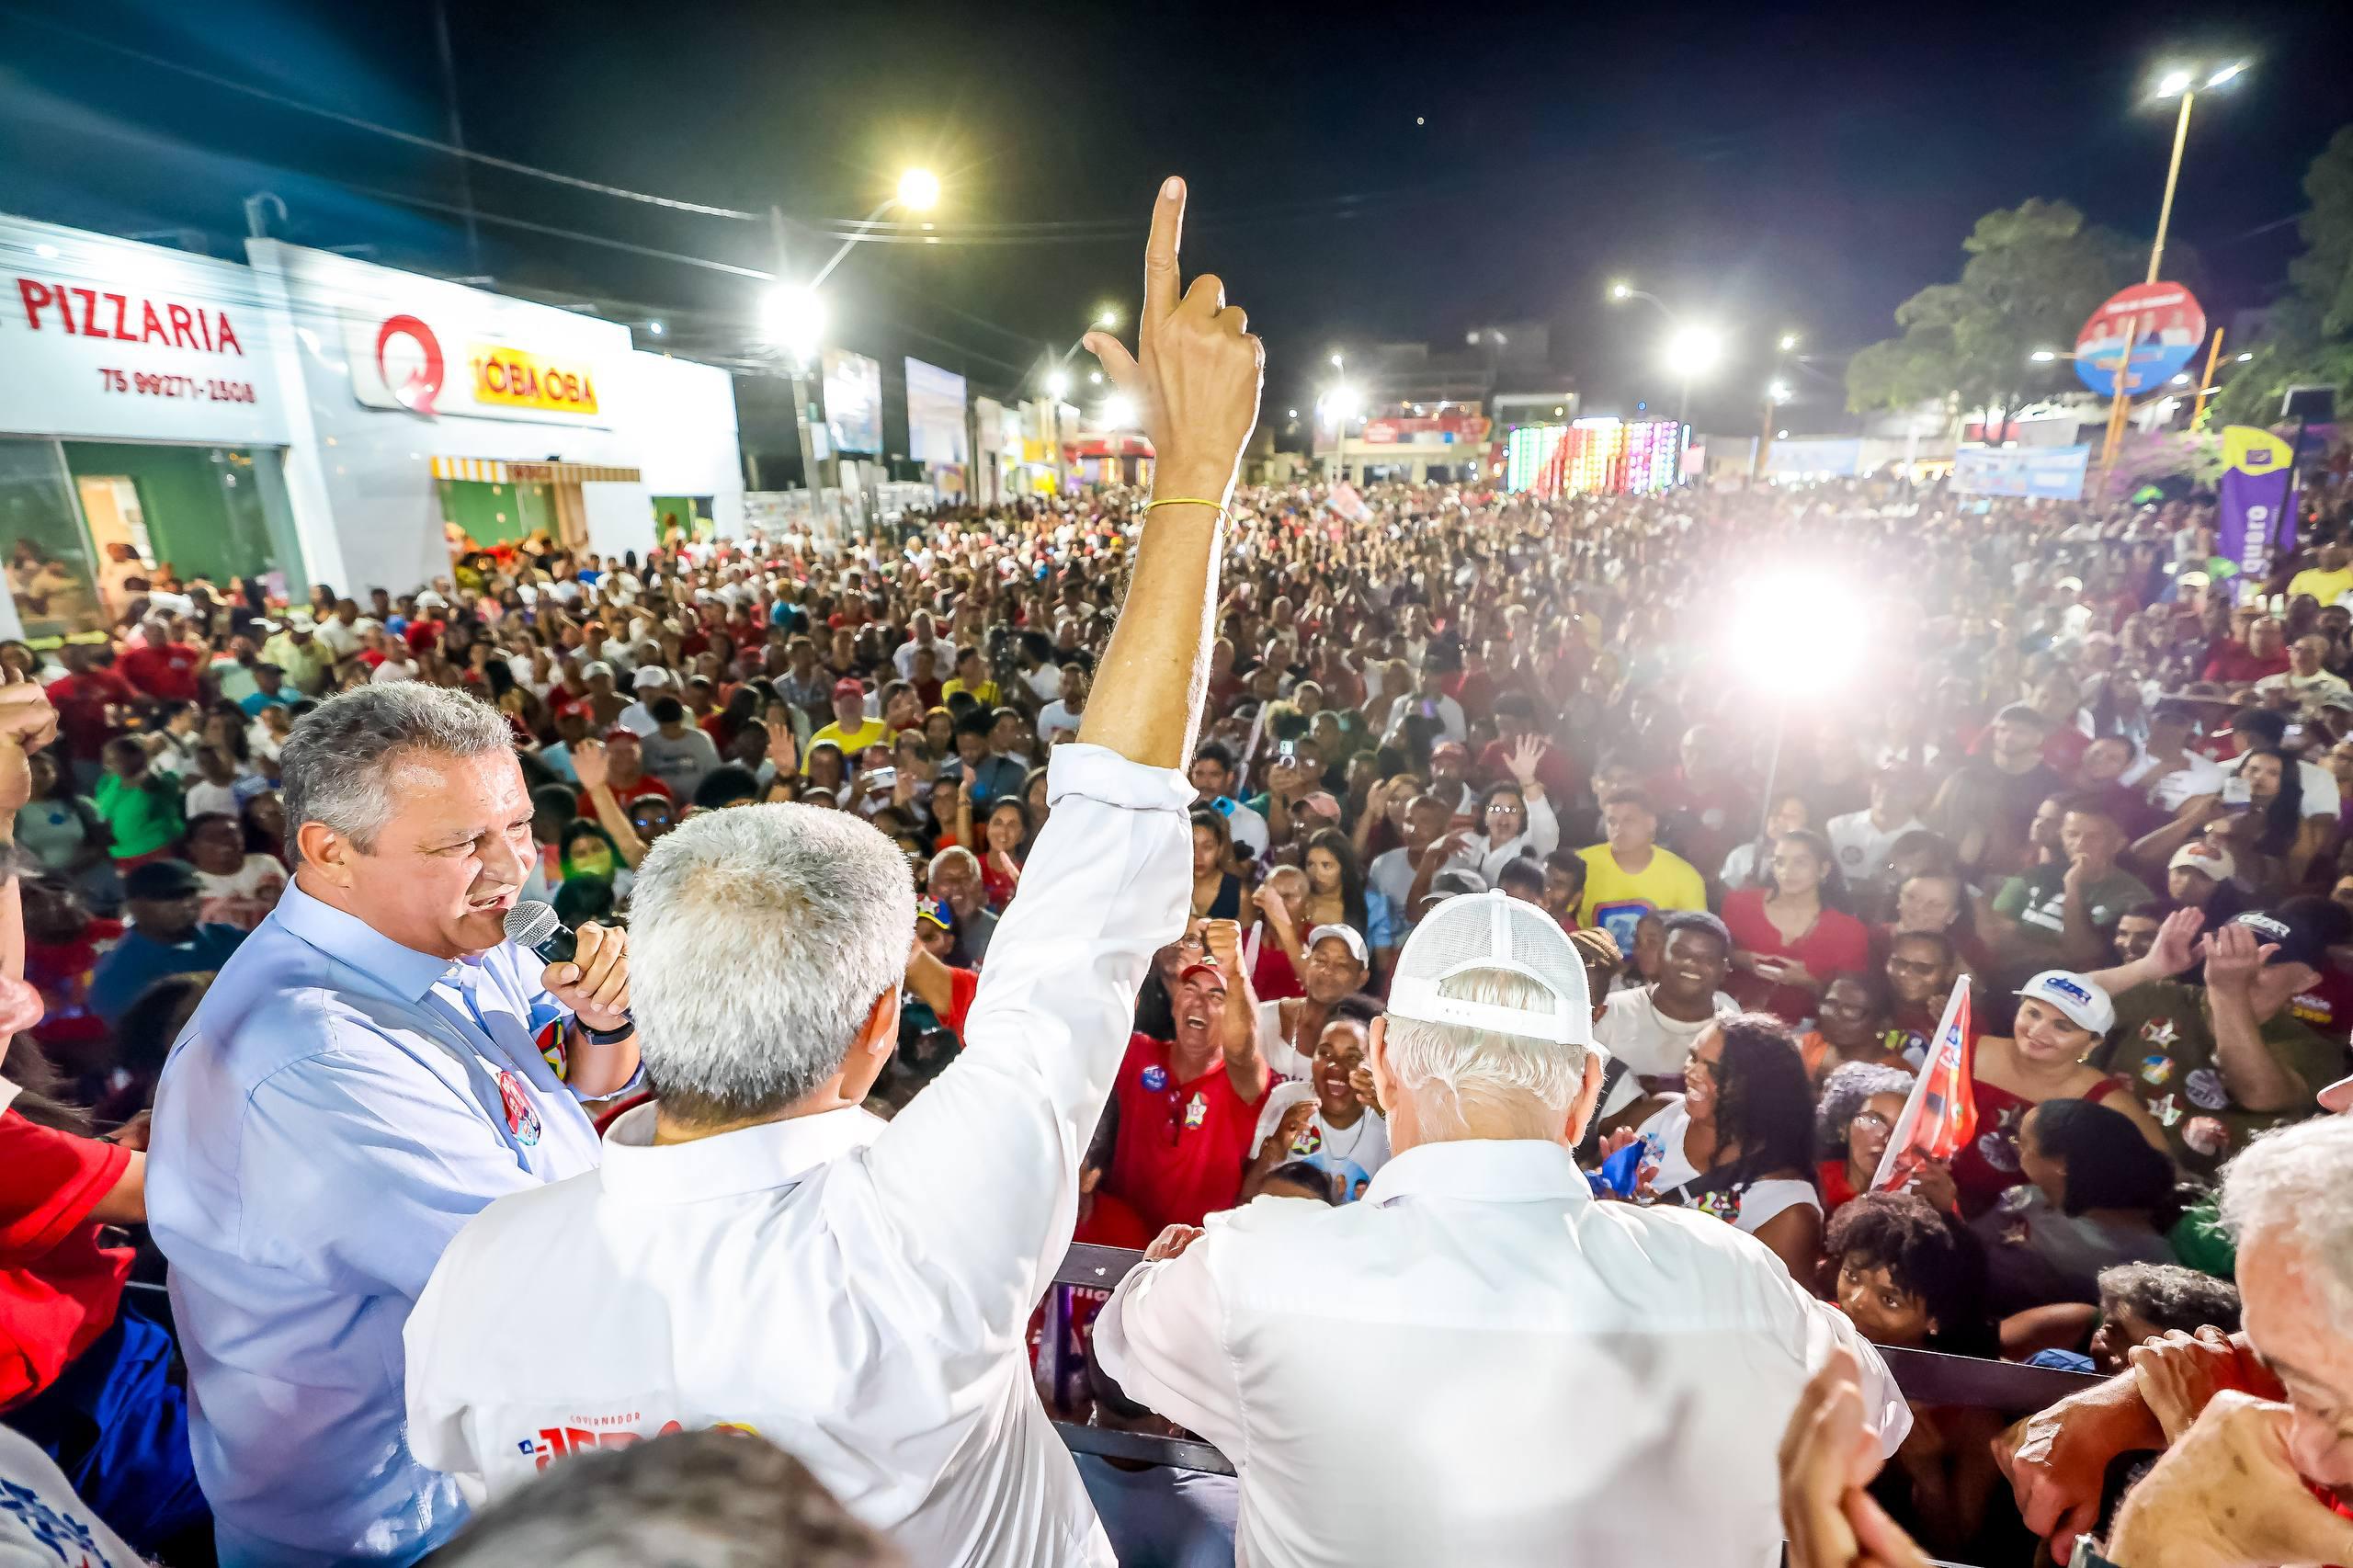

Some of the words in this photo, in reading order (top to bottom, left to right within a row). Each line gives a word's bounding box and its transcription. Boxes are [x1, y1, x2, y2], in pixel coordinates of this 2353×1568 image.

[16, 278, 244, 356] PIZZARIA
[97, 368, 129, 392] 75
[569, 1412, 641, 1426] GOVERNADOR
